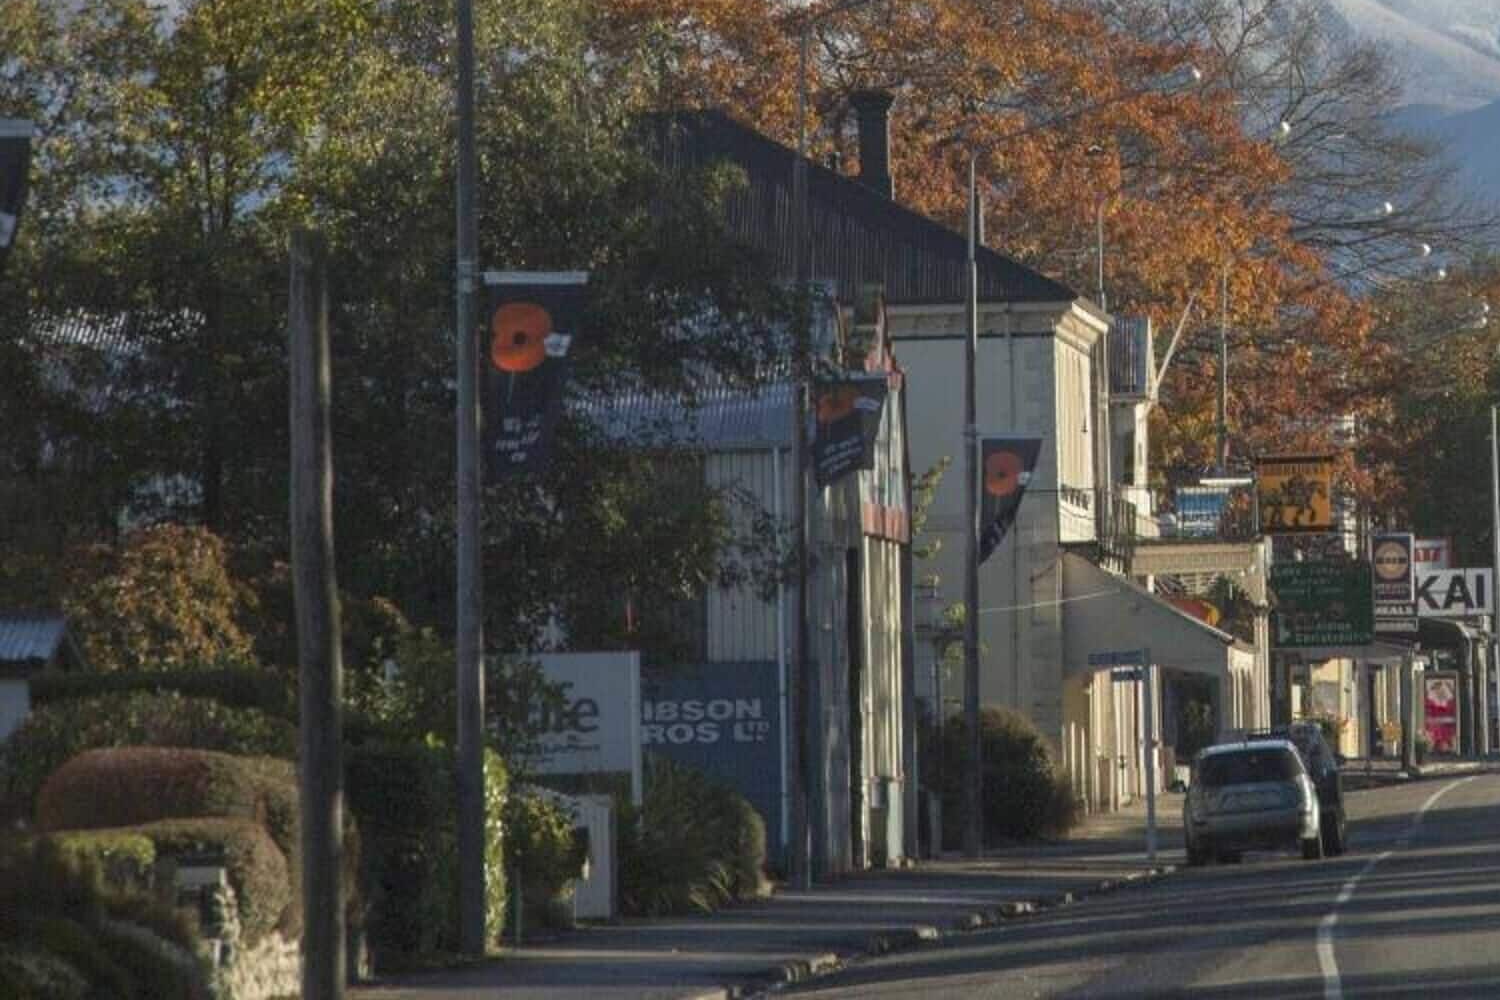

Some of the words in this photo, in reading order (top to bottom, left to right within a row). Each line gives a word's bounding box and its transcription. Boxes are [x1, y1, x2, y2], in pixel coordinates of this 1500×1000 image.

[1415, 574, 1485, 610] KAI
[639, 698, 762, 721] IBSON
[639, 722, 721, 745] ROS
